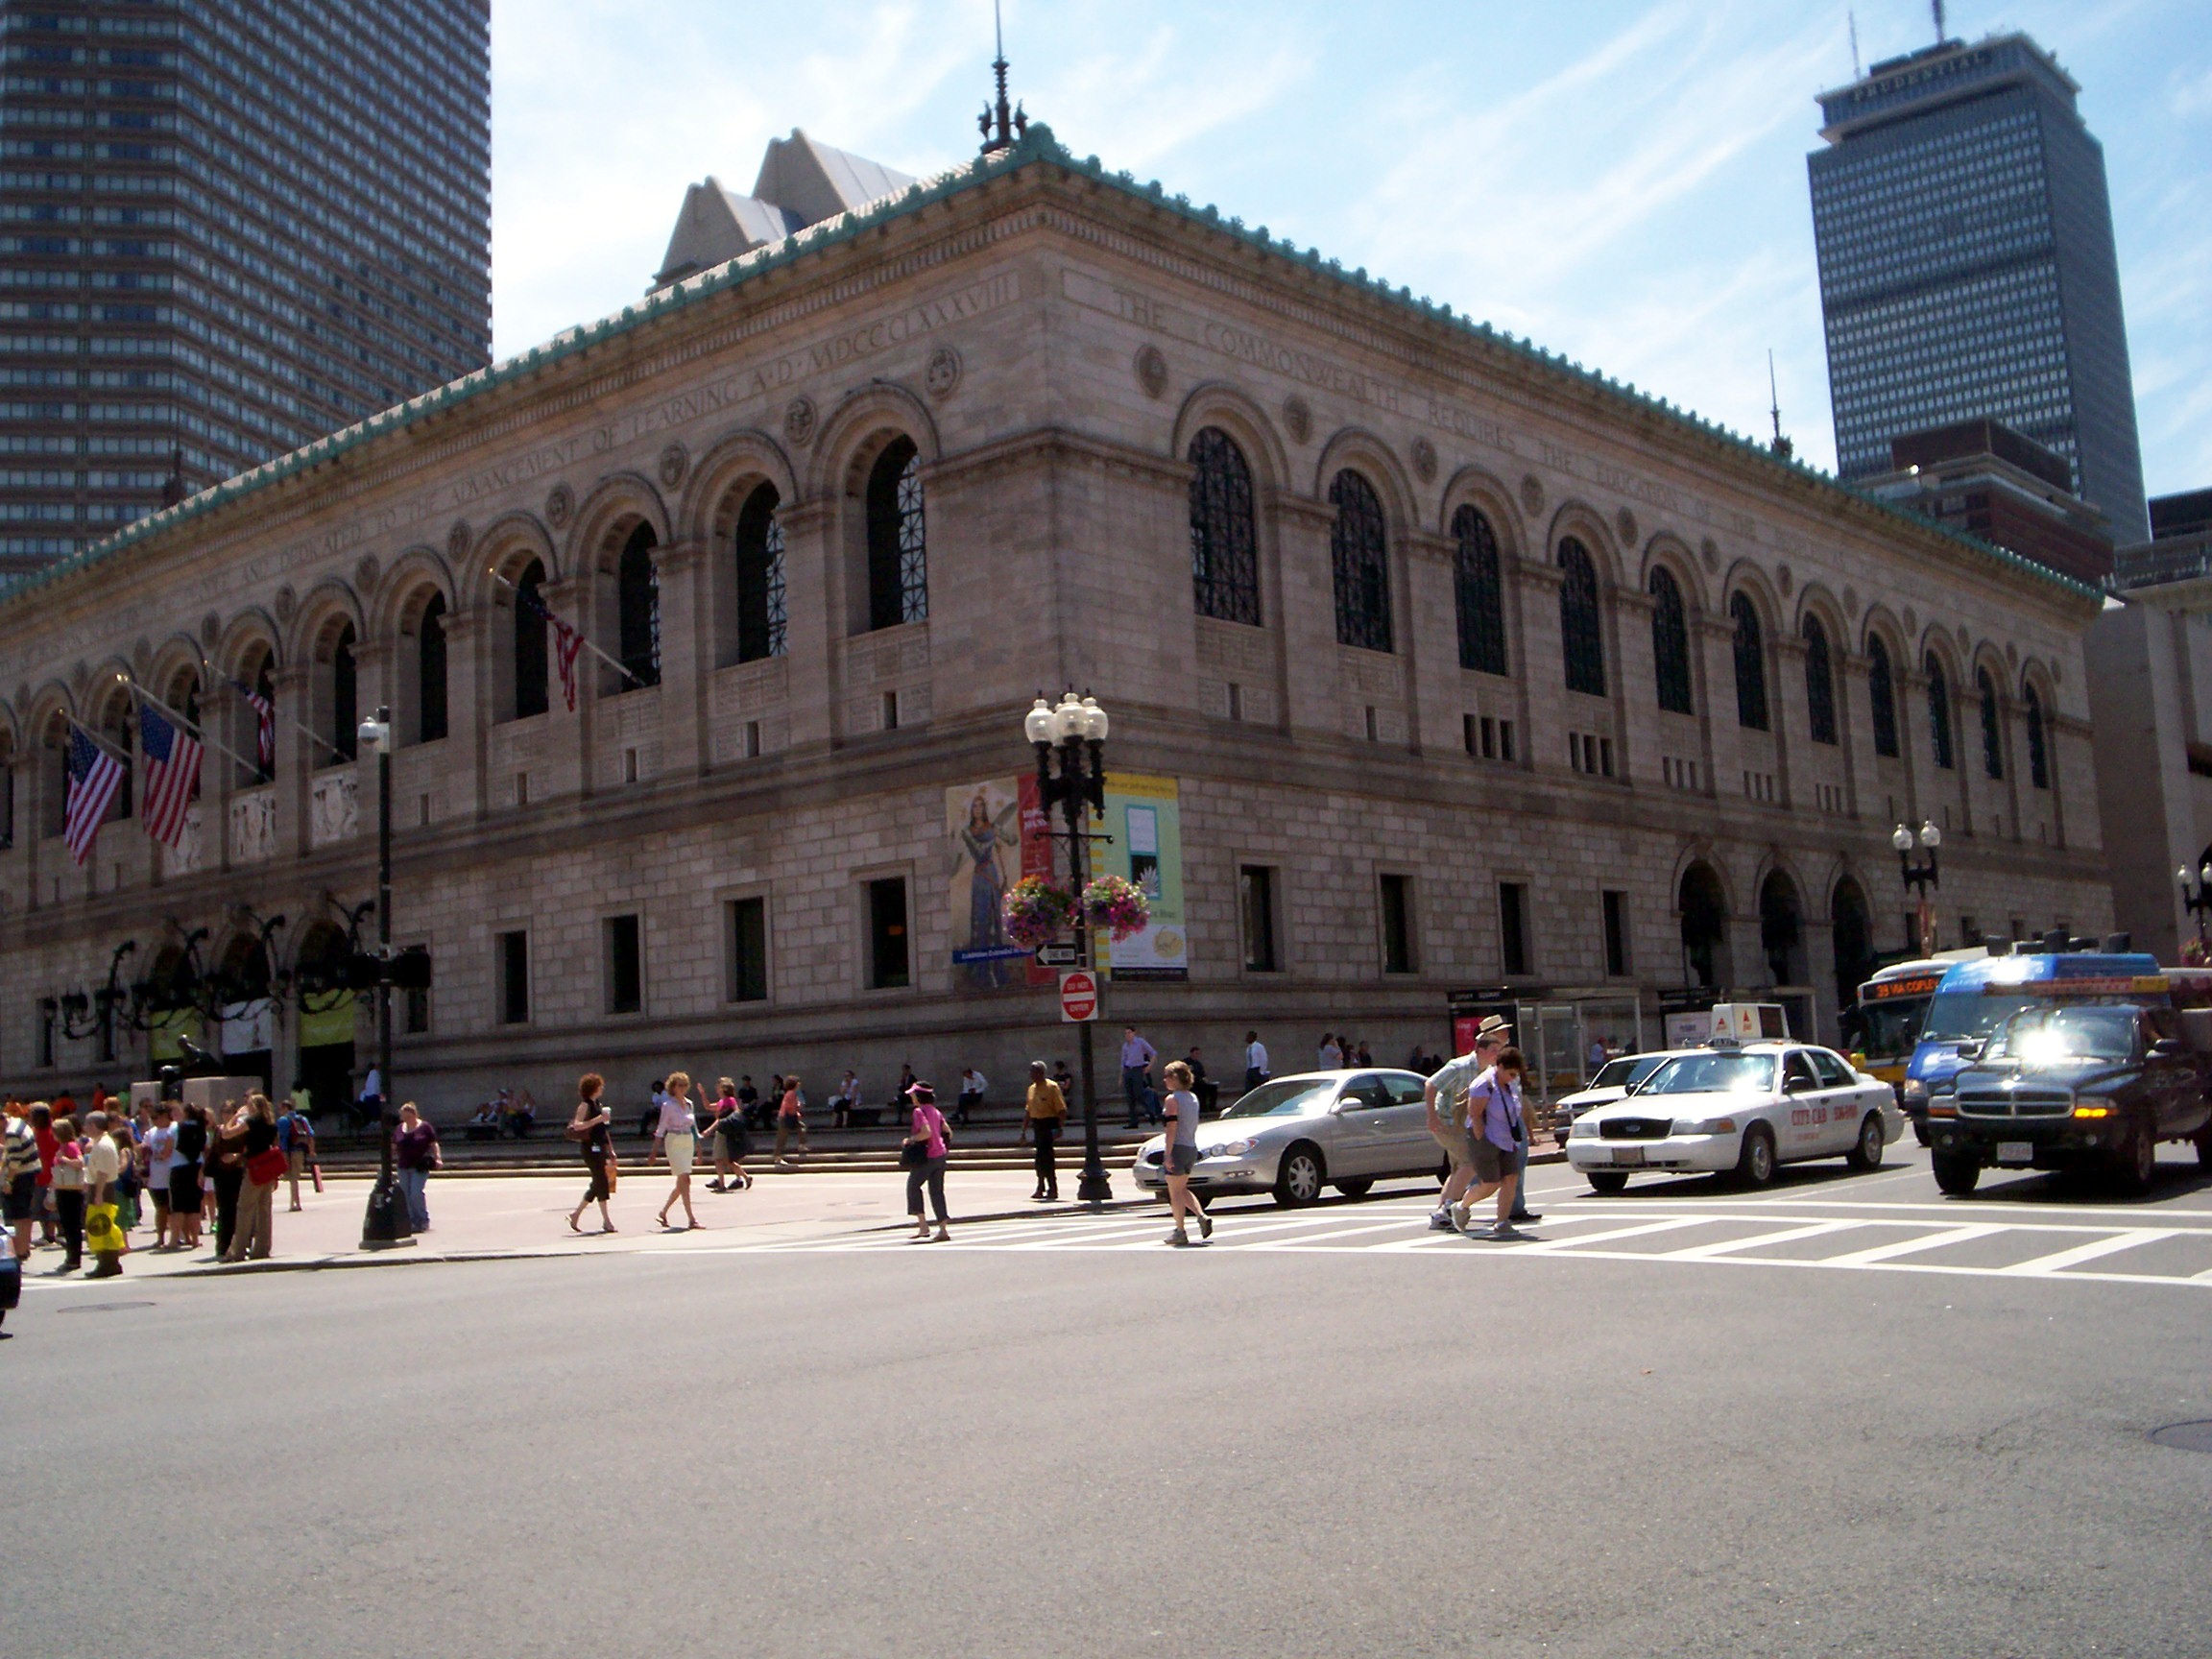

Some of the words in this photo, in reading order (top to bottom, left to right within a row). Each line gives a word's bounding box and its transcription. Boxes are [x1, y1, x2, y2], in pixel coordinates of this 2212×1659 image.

[1114, 289, 1167, 332] THE
[1204, 321, 1400, 412] COMMONWEALTH
[1427, 399, 1516, 449] REQUIRES
[1539, 439, 1575, 469] THE
[375, 505, 397, 531] TO
[405, 491, 438, 519] THE
[449, 439, 578, 507] ADVANCEMENT
[592, 422, 618, 451] OF
[633, 382, 739, 439] LEARNING
[1077, 981, 1089, 990] NOT
[1876, 984, 1889, 998] 39
[1890, 982, 1905, 995] VIA
[1791, 1109, 1810, 1126] CITY
[1812, 1107, 1827, 1124] CAB
